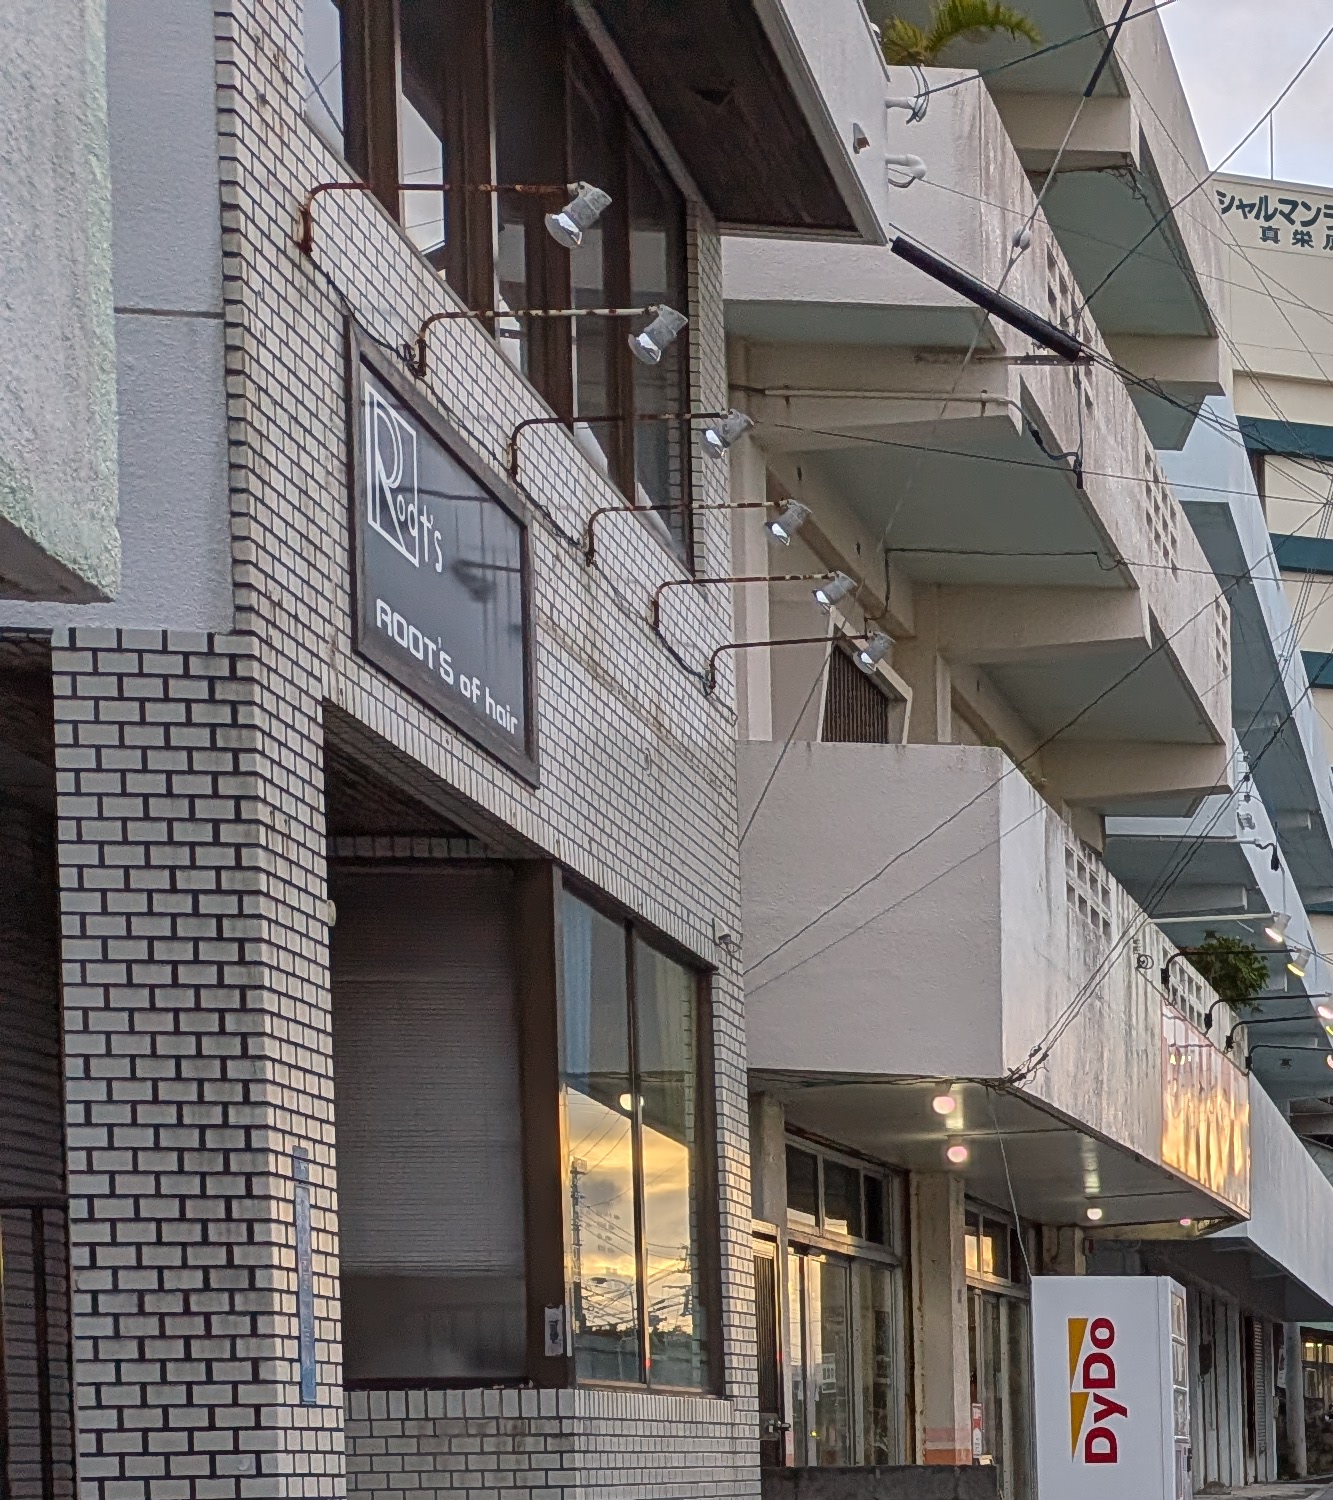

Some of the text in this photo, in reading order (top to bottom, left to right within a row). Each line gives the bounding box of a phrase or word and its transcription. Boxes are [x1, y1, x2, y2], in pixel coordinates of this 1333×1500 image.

[376, 598, 519, 736] ROOT'S of hair
[1082, 1316, 1129, 1465] DyDo
